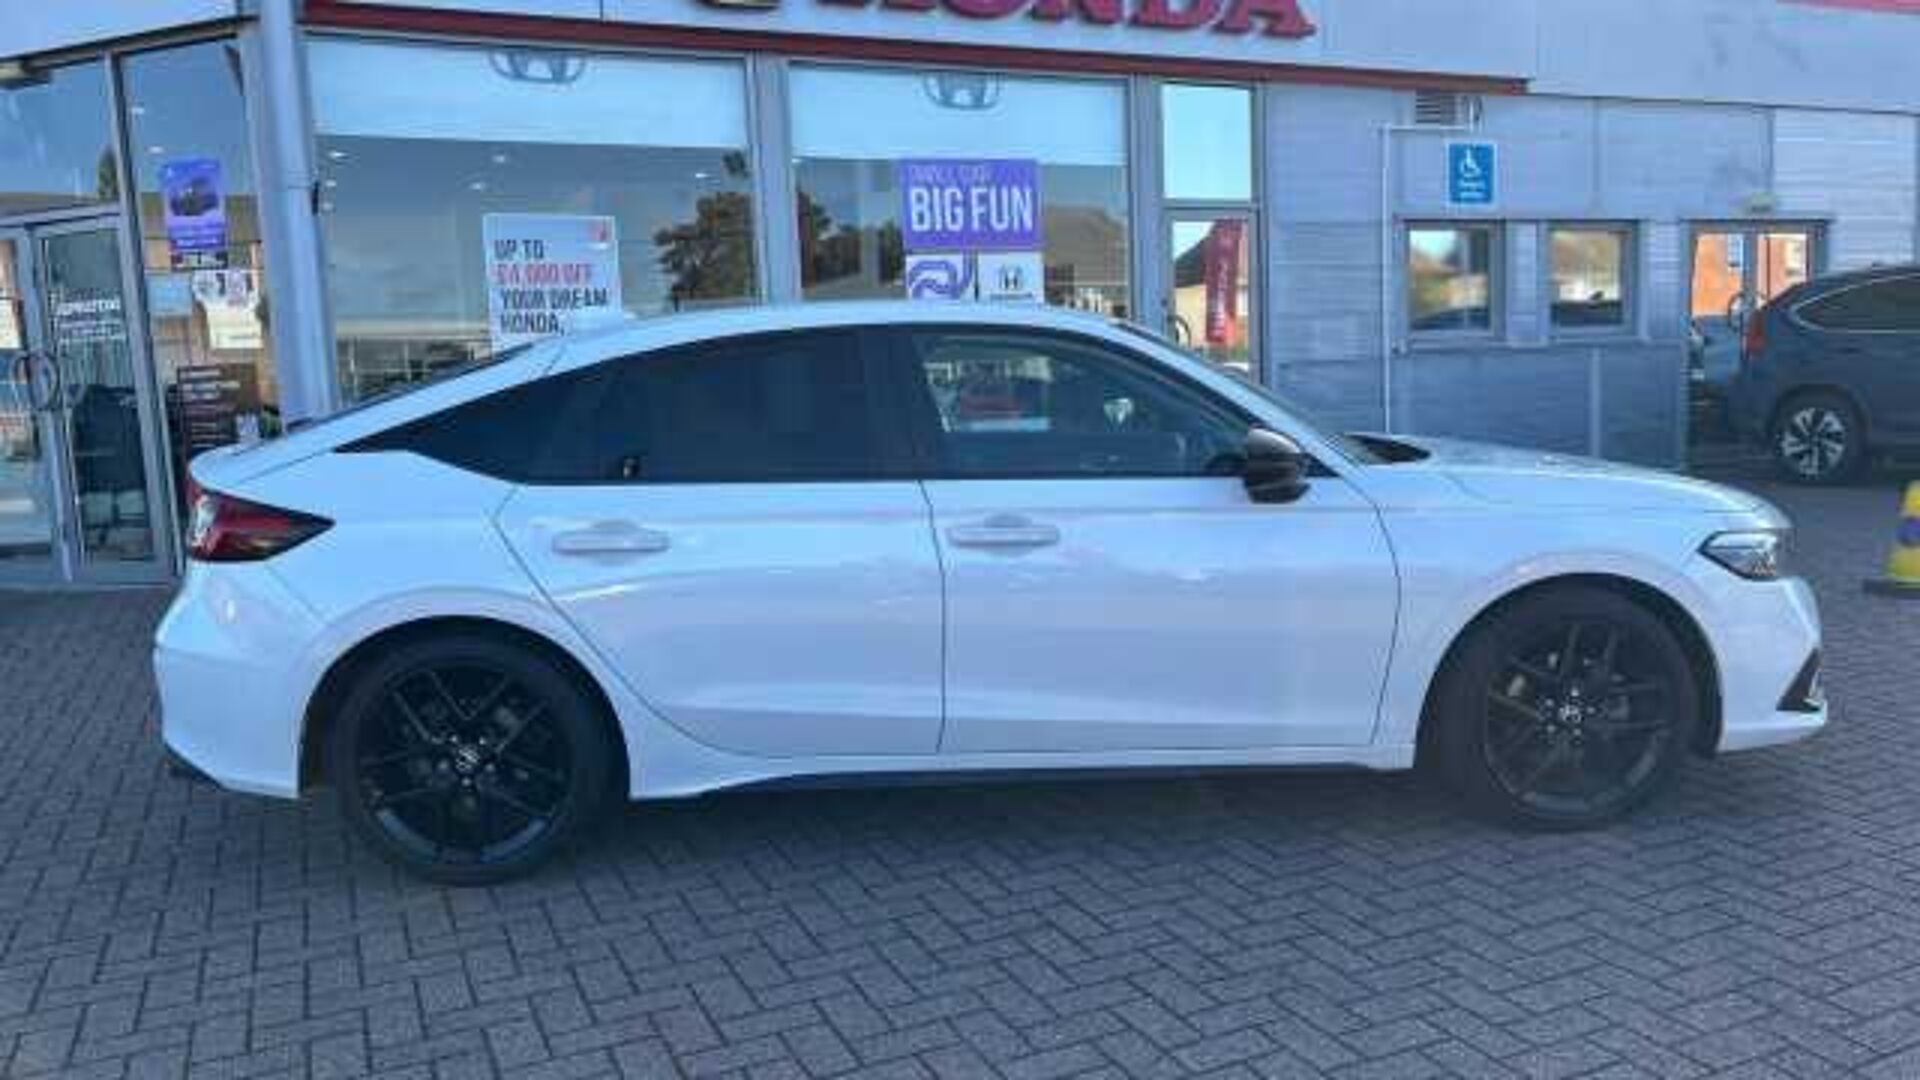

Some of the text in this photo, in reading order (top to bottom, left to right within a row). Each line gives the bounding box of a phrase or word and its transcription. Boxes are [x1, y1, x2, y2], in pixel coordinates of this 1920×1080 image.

[910, 185, 1034, 232] BIG FUN
[494, 239, 545, 260] UP TO
[500, 287, 609, 310] YOUR DREAM
